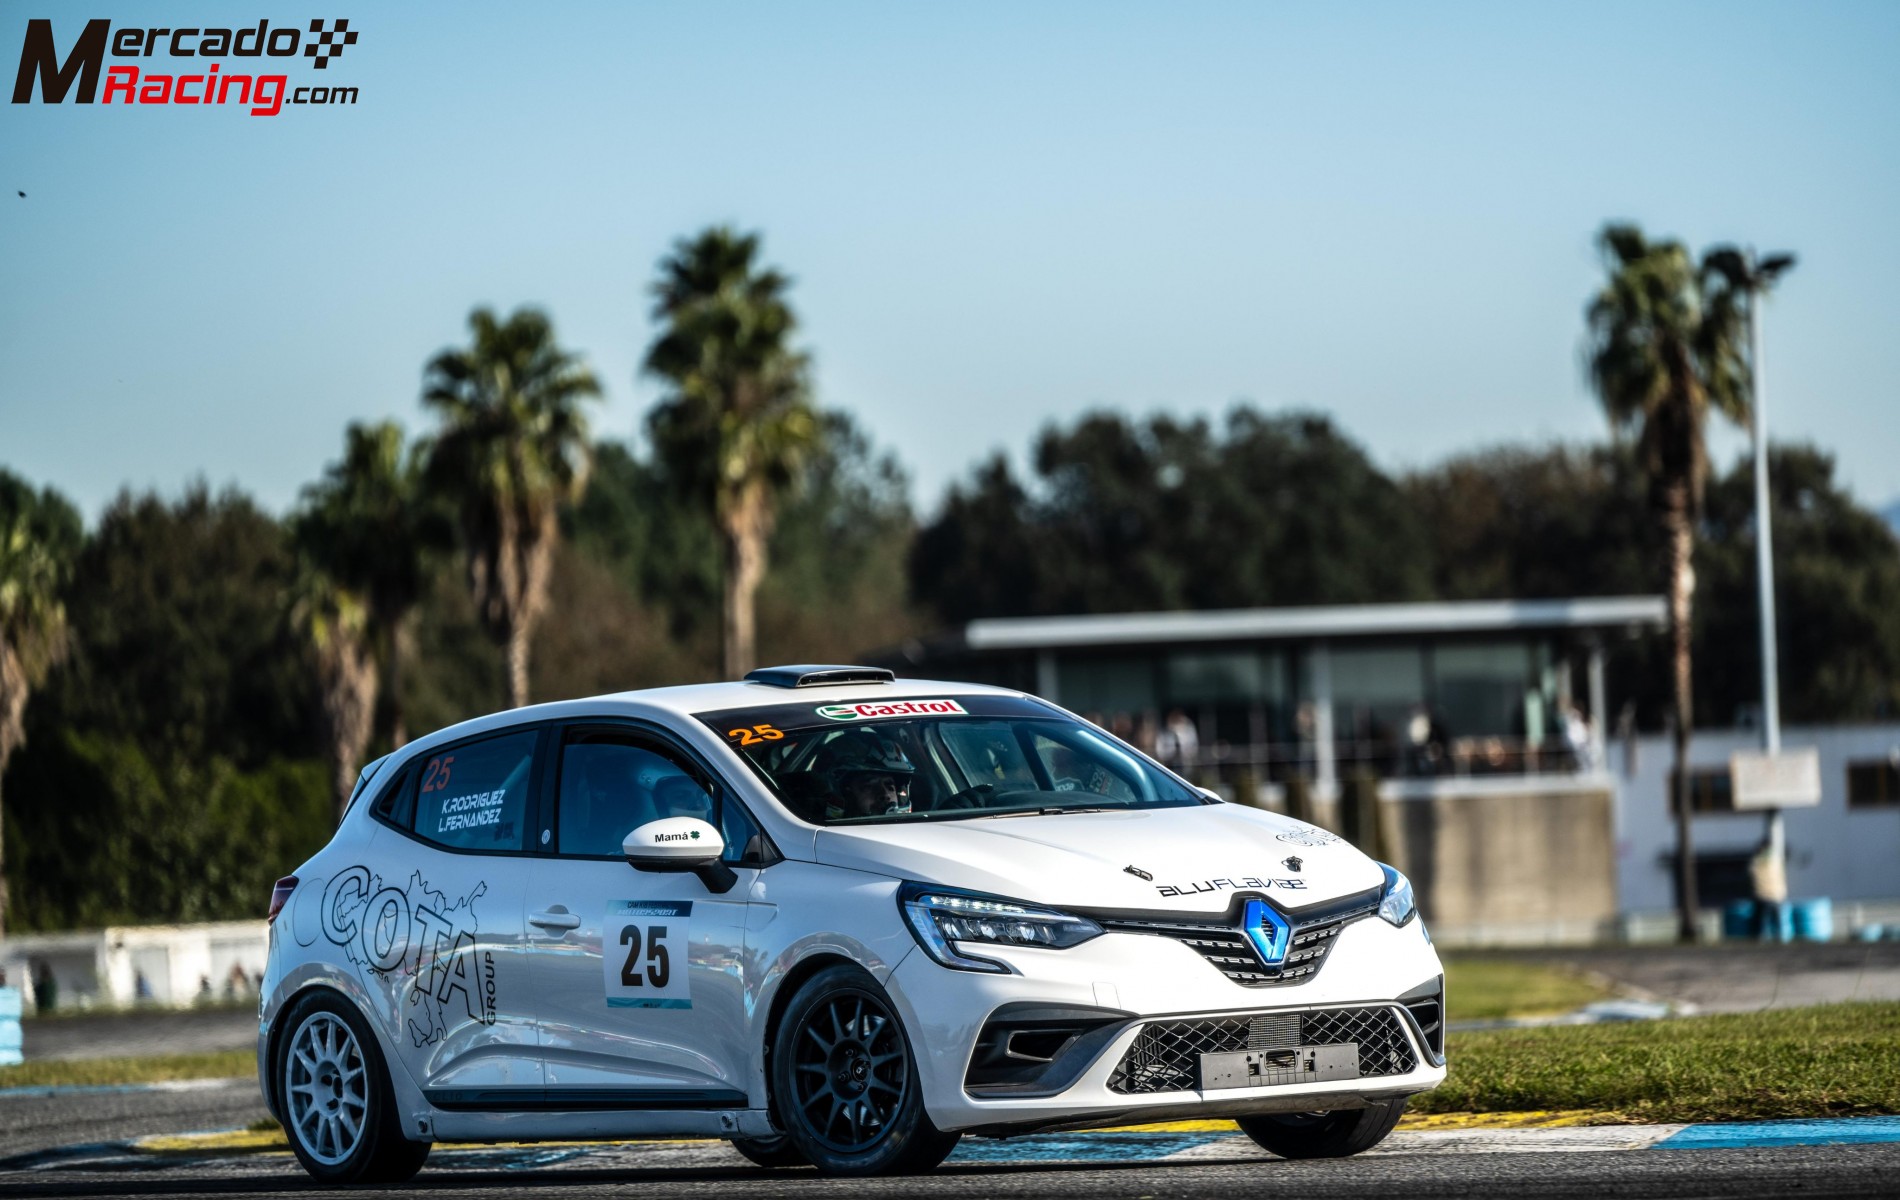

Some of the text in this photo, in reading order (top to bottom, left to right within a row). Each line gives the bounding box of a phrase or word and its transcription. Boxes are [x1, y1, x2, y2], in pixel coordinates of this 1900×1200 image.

[855, 701, 963, 716] Castrol
[728, 724, 784, 746] 25
[422, 757, 454, 792] 25
[441, 789, 505, 814] K.RODRIGUEZ
[438, 808, 501, 832] L.FERNANDEZ
[654, 832, 688, 842] Mamá
[321, 865, 486, 1026] COTA
[620, 924, 669, 988] 25
[485, 951, 496, 1026] GROUP
